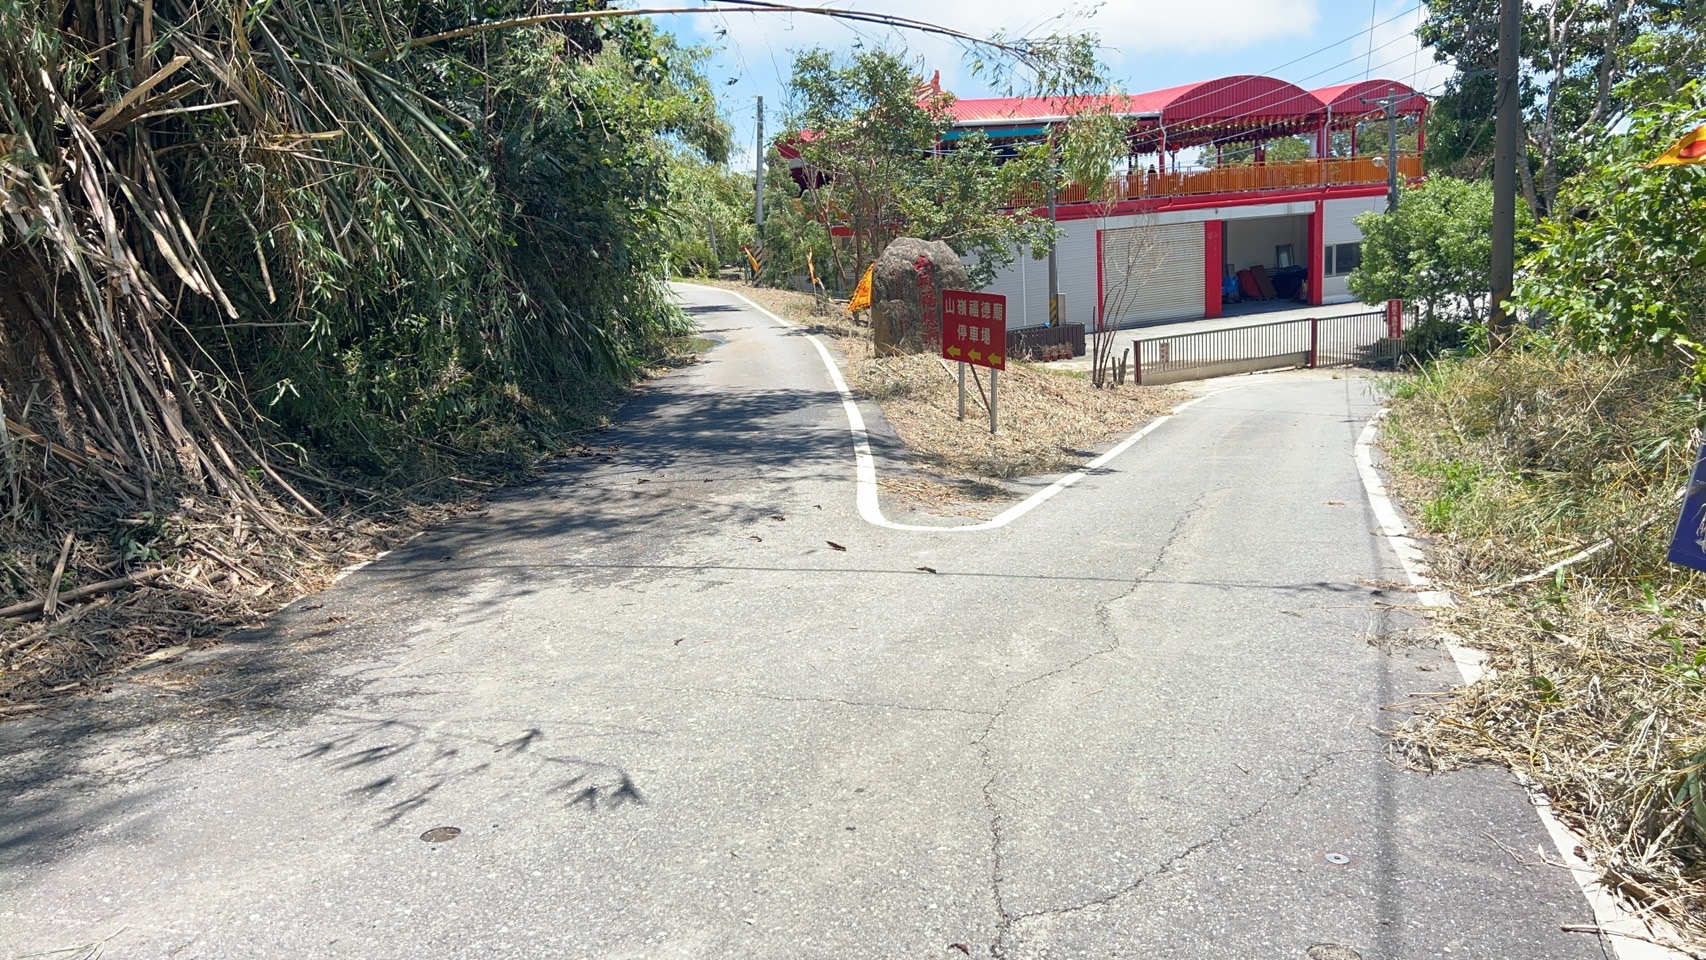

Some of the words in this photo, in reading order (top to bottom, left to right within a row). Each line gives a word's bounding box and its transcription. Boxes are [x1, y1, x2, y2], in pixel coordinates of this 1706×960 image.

[945, 297, 1003, 321] 山嶺福德廟
[957, 324, 991, 346] 停車場
